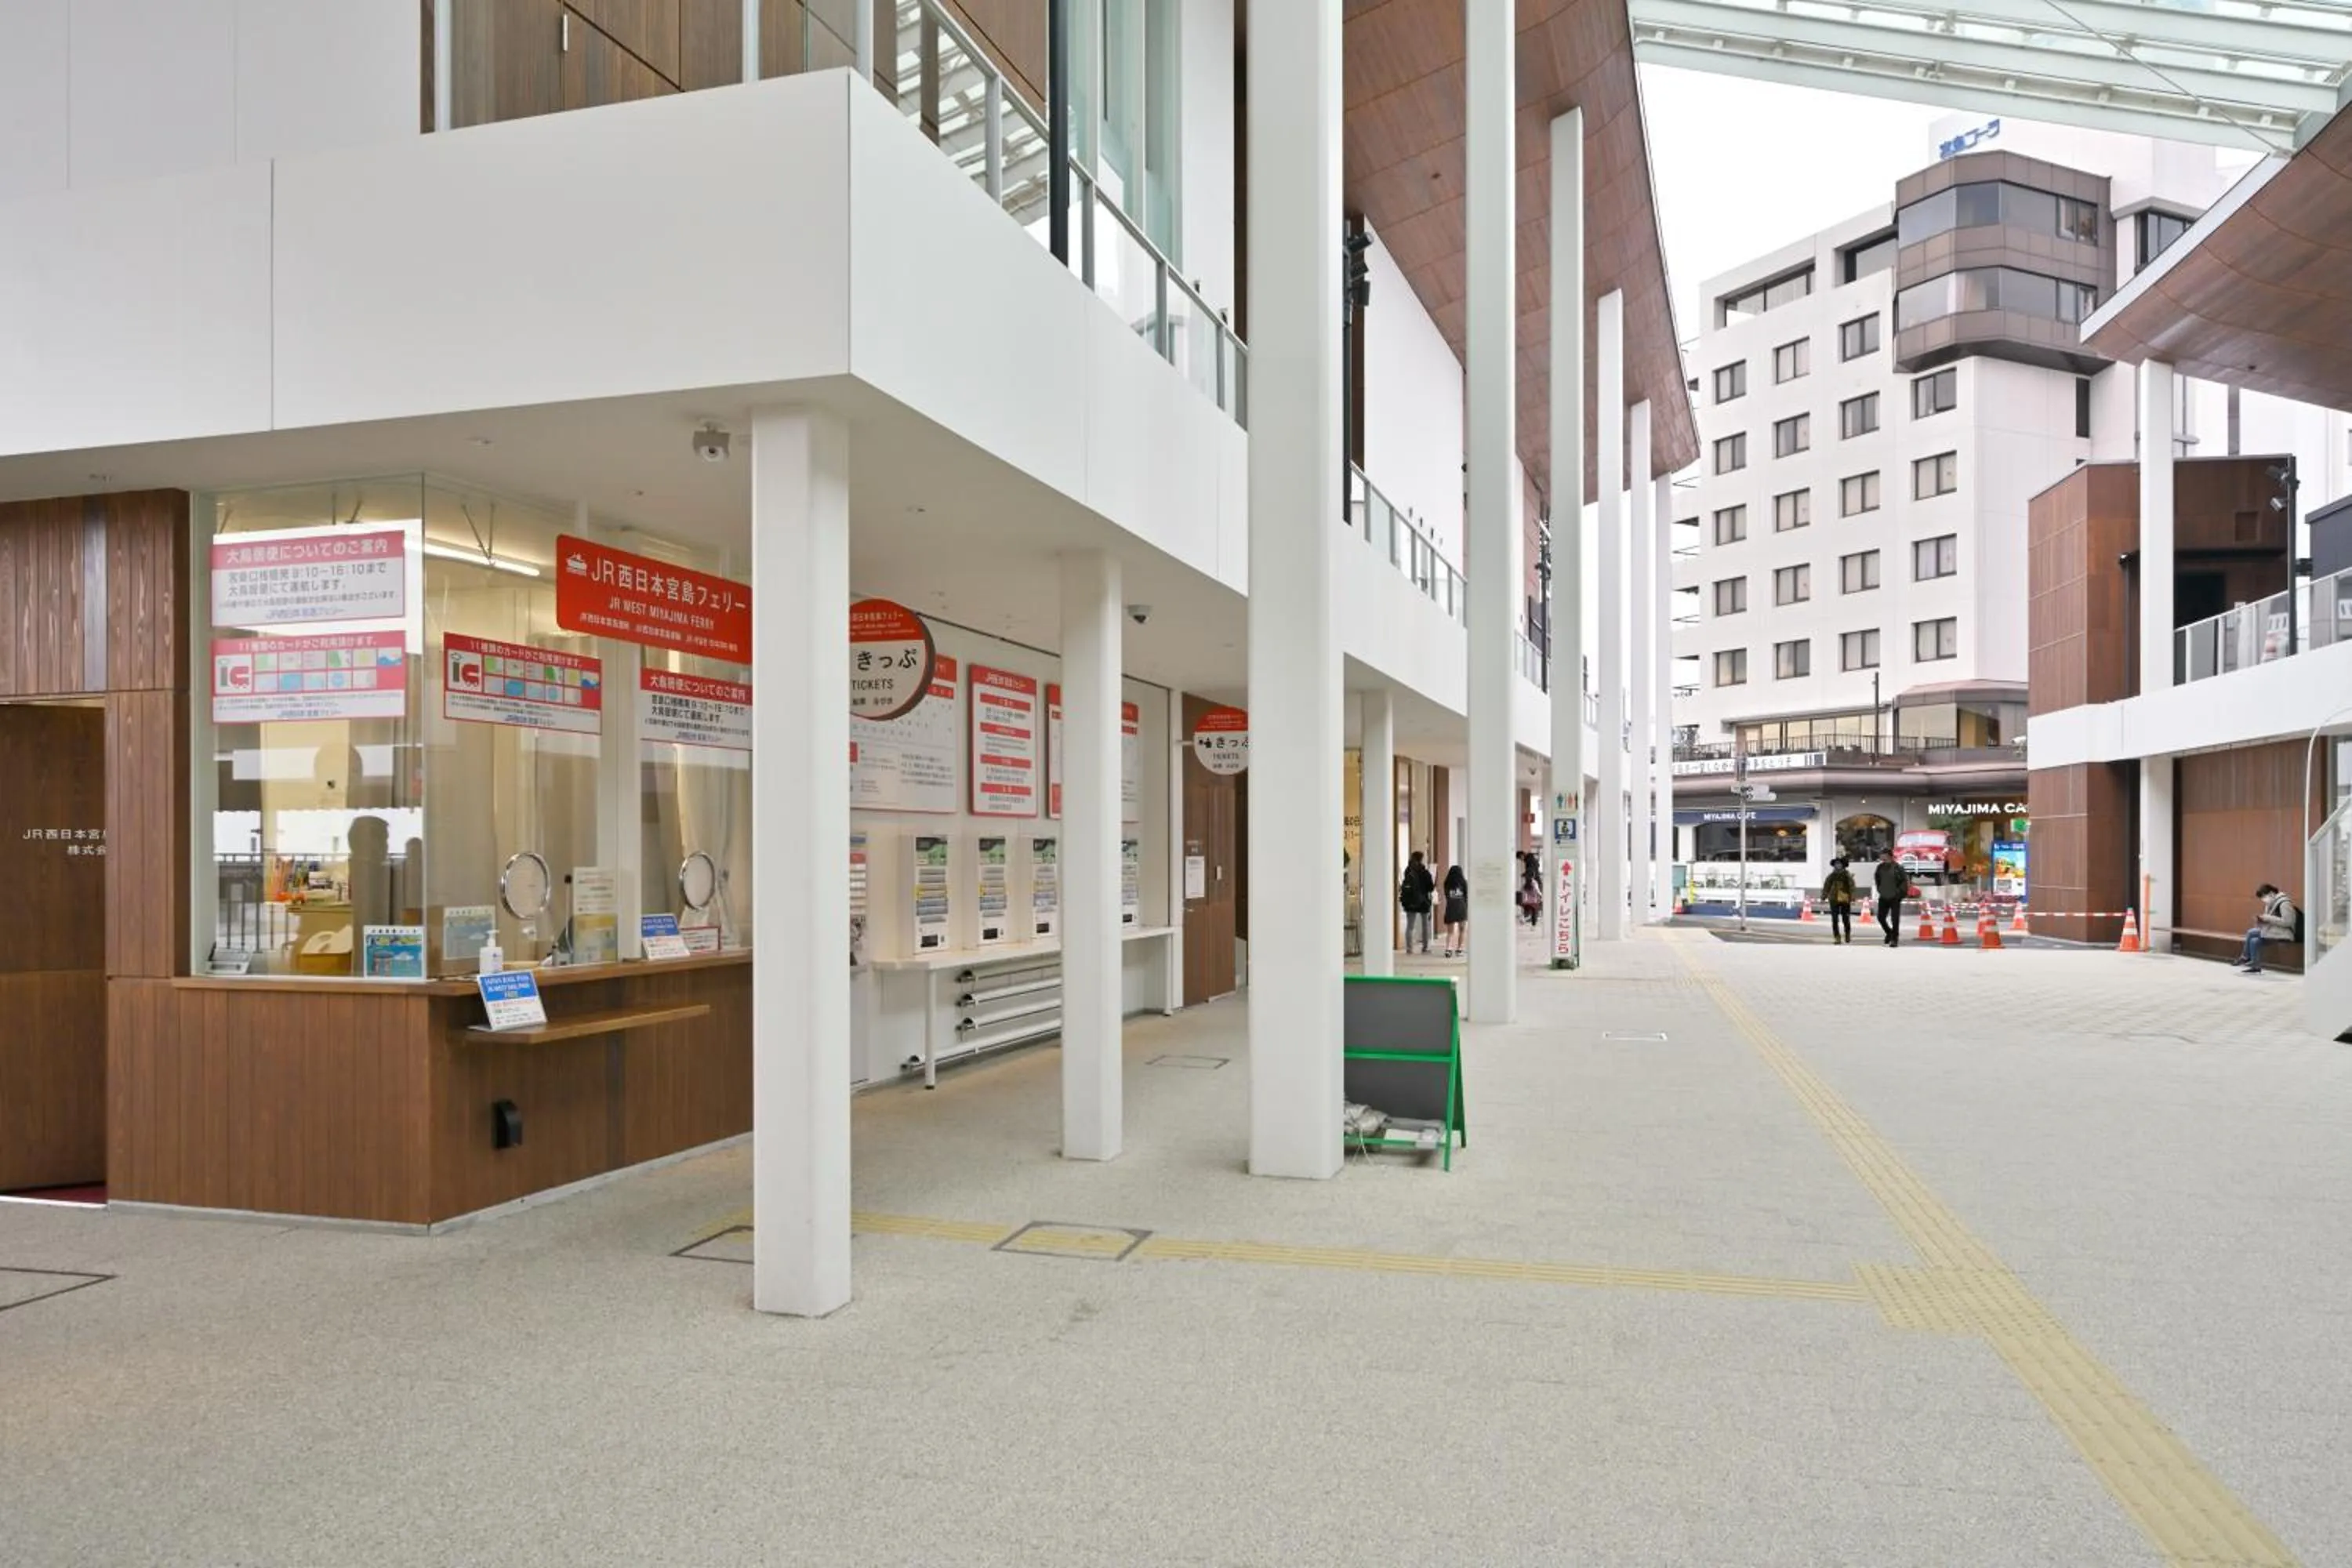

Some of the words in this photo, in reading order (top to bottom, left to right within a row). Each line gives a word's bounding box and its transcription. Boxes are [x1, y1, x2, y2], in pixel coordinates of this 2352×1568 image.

[591, 556, 747, 612] JR西日本宮島フェリー
[608, 597, 621, 610] JR
[623, 601, 647, 615] WEST
[649, 604, 688, 626] MIYAJIMA
[691, 615, 715, 631] FERRY
[857, 648, 917, 671] きっぷ
[851, 678, 894, 691] TICKETS
[1704, 812, 1736, 821] MIYAJIMA
[1737, 811, 1756, 820] CFE
[1928, 803, 2001, 815] MIYAJIMA
[2004, 802, 2028, 814] CA
[1558, 880, 1572, 954] トイレこちら
